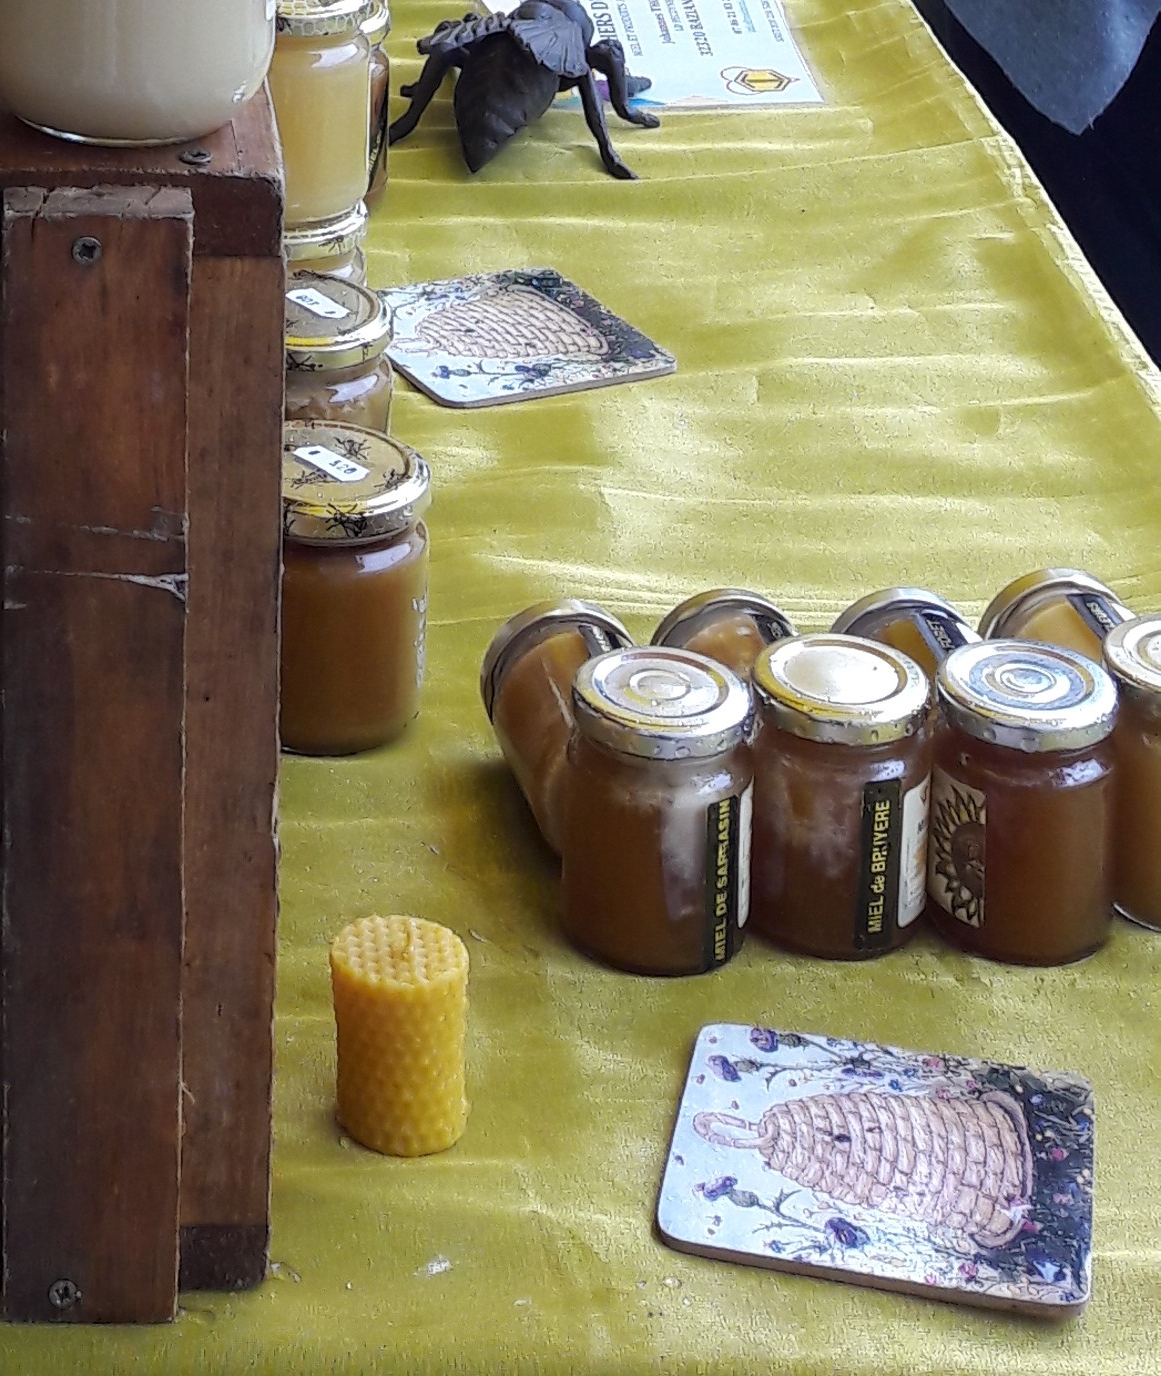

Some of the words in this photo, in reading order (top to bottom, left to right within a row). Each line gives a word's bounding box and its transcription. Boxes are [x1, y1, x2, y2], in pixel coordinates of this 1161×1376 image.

[592, 12, 619, 41] HERS
[716, 798, 731, 889] SARRASIN
[870, 874, 886, 894] de
[715, 891, 728, 917] DE
[867, 895, 885, 934] MIEL
[714, 918, 728, 961] MIEL
